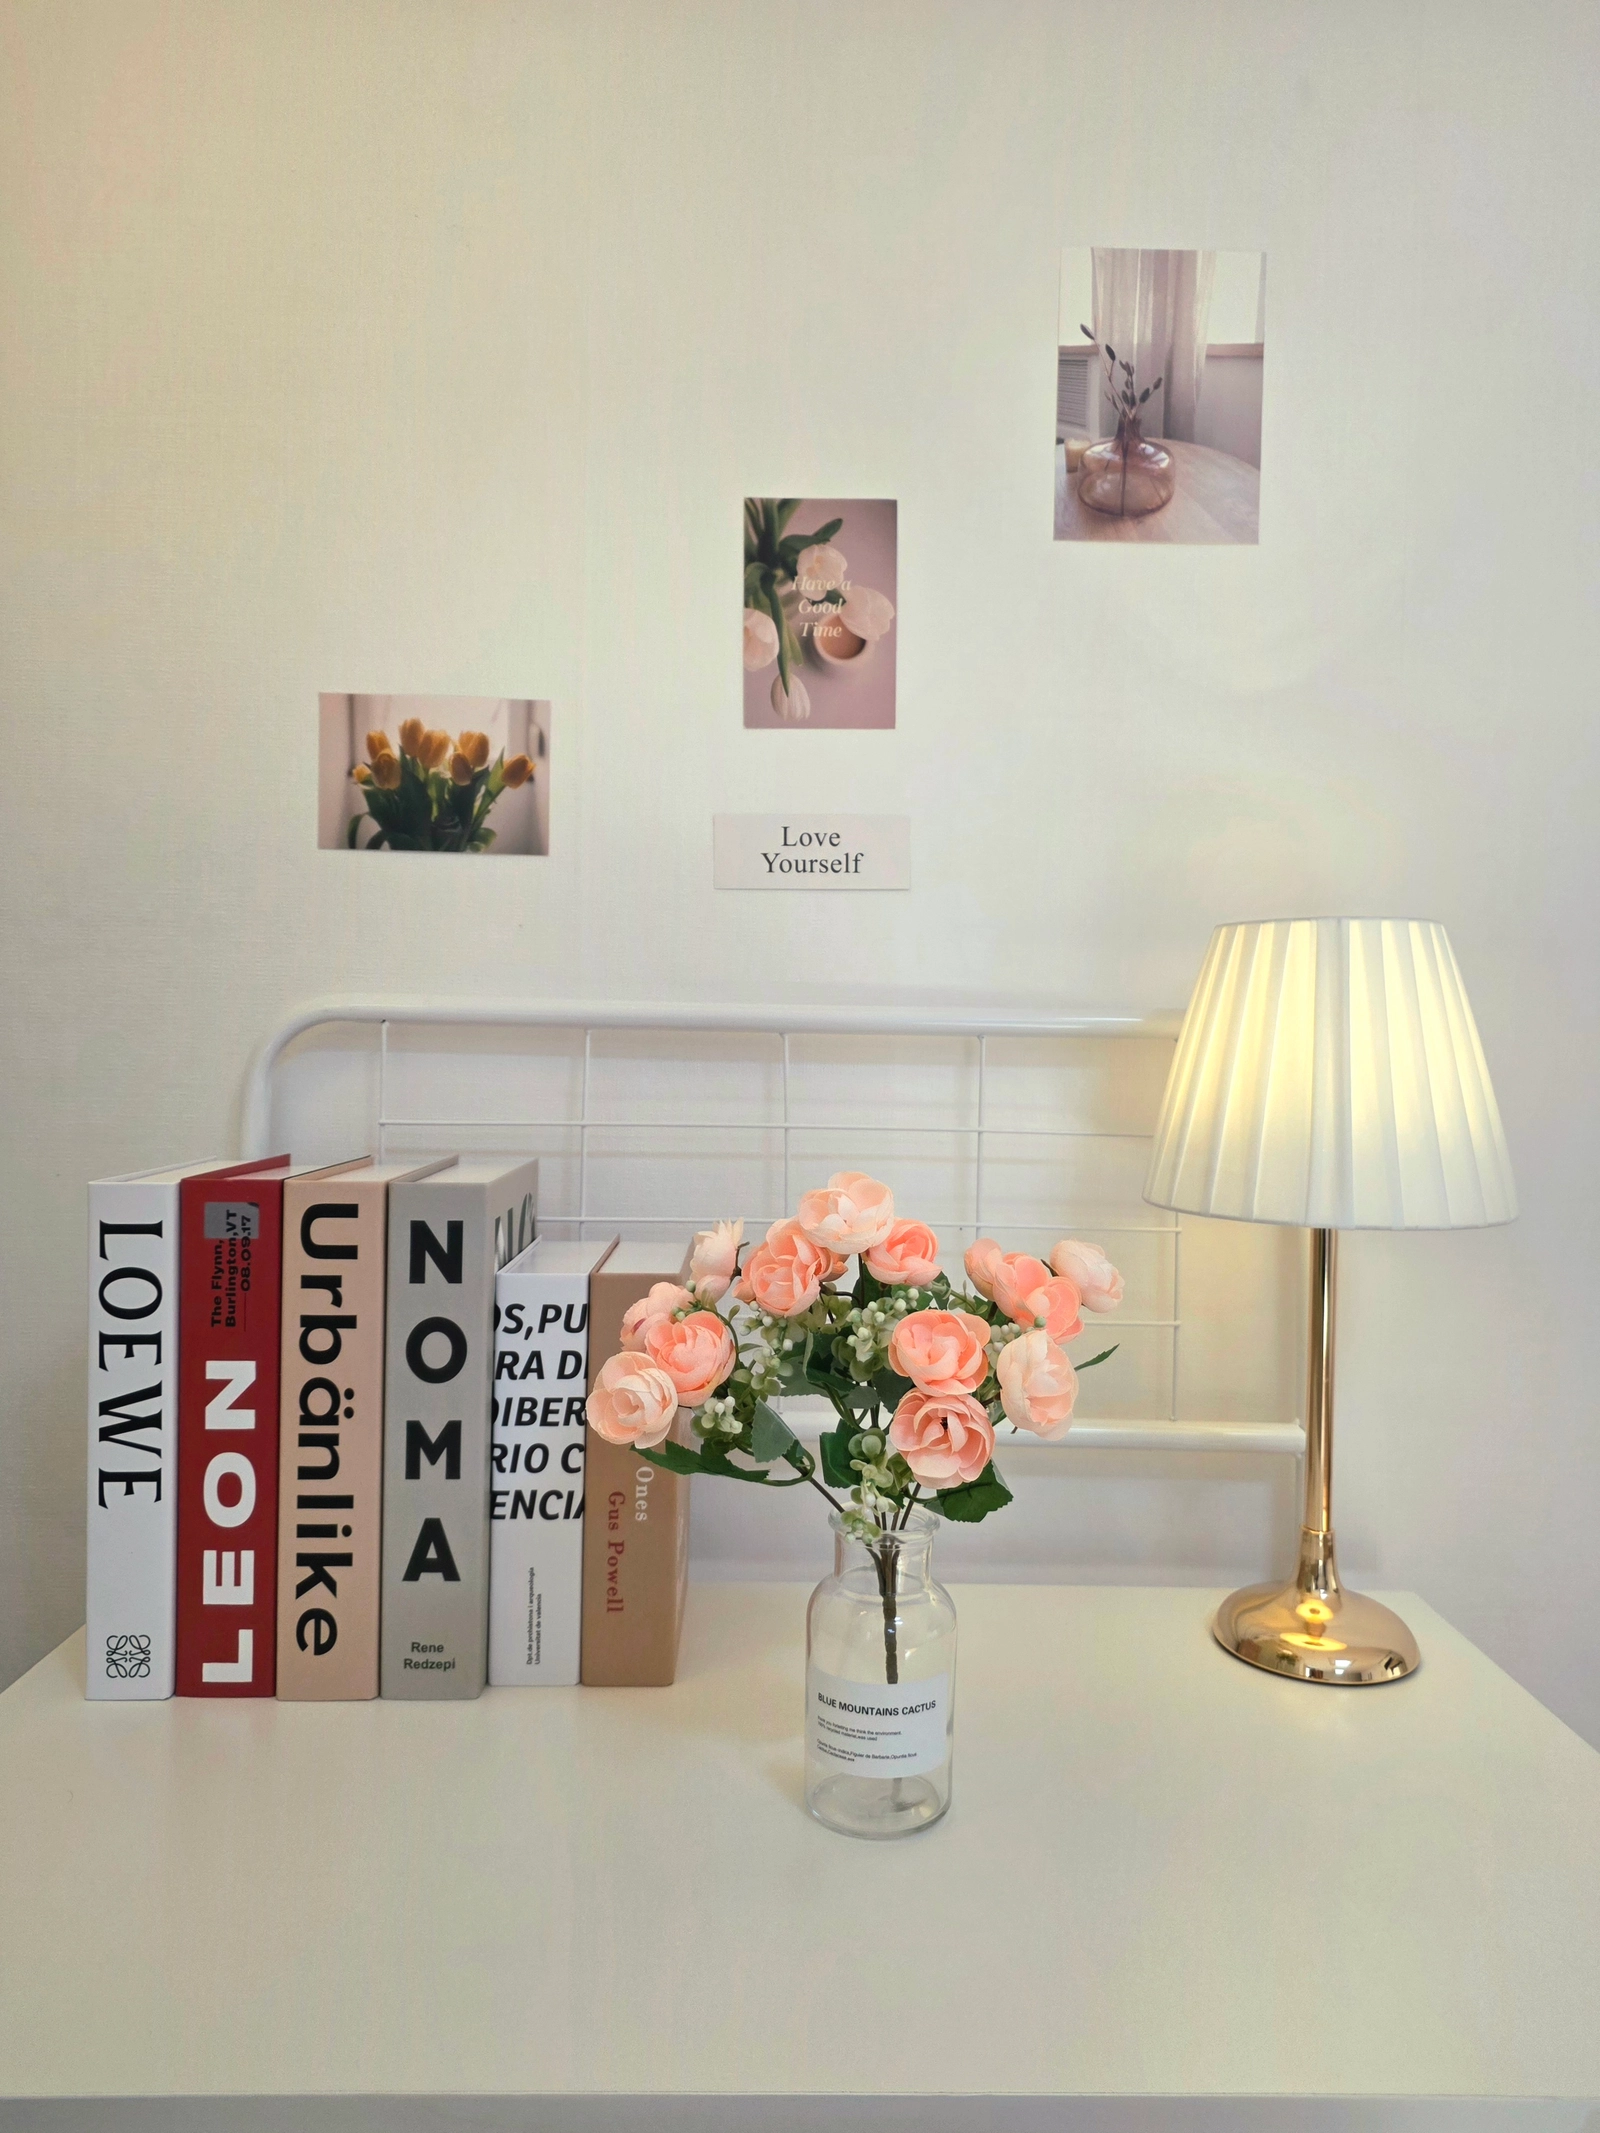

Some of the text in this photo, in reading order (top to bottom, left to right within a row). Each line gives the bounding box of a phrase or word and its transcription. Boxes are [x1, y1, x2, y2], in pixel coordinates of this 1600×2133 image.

[792, 576, 851, 591] Have a
[798, 598, 843, 614] Good
[800, 621, 842, 637] Time
[781, 825, 841, 847] Love
[760, 852, 865, 874] Yourself
[225, 1209, 239, 1327] Burlington,VT
[241, 1215, 252, 1292] 08.09.17
[211, 1239, 225, 1327] The Flynn,
[98, 1219, 163, 1510] LOEWE
[402, 1220, 468, 1582] NOMA
[295, 1203, 359, 1657] Urbänlike
[635, 1466, 654, 1521] Ones
[202, 1360, 257, 1684] LEON
[606, 1491, 626, 1613] Gus Powell
[535, 1620, 541, 1629] de
[403, 1658, 456, 1672] Redzepi
[411, 1641, 444, 1653] Rene
[818, 1692, 936, 1716] BLUE MOUNTAINS CACTUS
